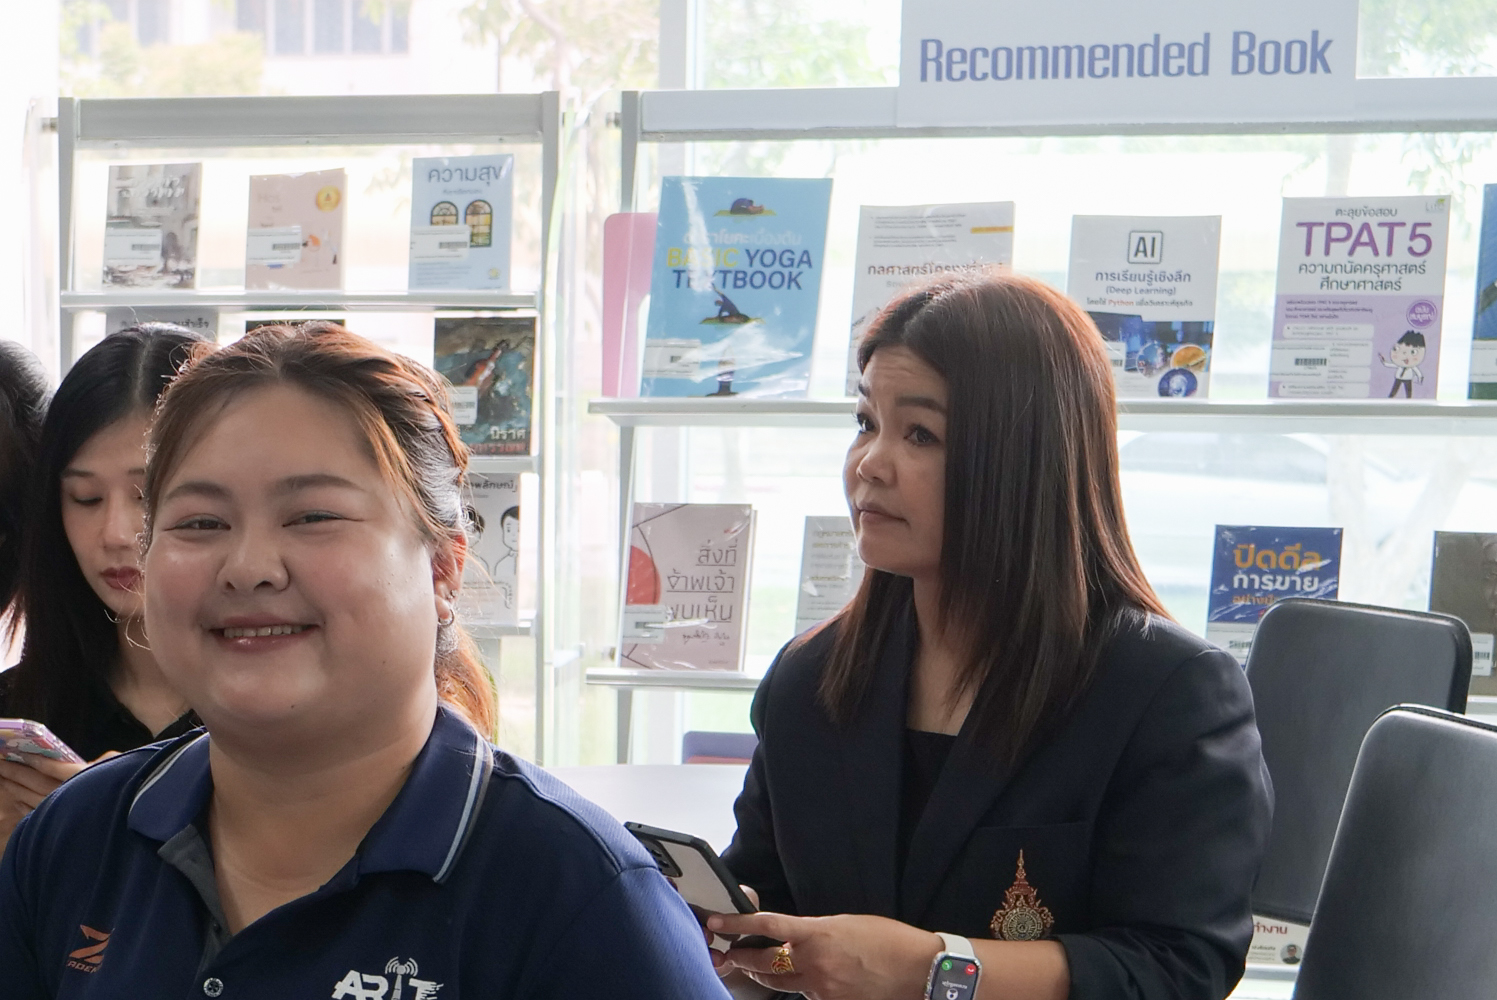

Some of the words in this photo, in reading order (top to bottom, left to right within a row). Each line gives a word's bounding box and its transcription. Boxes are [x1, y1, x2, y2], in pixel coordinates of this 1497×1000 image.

[919, 33, 1211, 82] Recommended
[1230, 30, 1333, 76] Book
[1335, 205, 1398, 220] ตะลุยข้อสอบ
[1133, 236, 1157, 258] AI
[745, 248, 813, 269] YOGA
[1095, 269, 1192, 286] การเรียนรู้เชิงลึก
[1298, 260, 1427, 279] ความถนัดครุศาสตร์
[1319, 275, 1403, 292] ศึกษาศาสตร์
[1108, 299, 1134, 308] Python
[697, 539, 739, 565] สิ่งที่
[1233, 543, 1322, 571] ปิดดีล
[1232, 573, 1319, 592] การขาย
